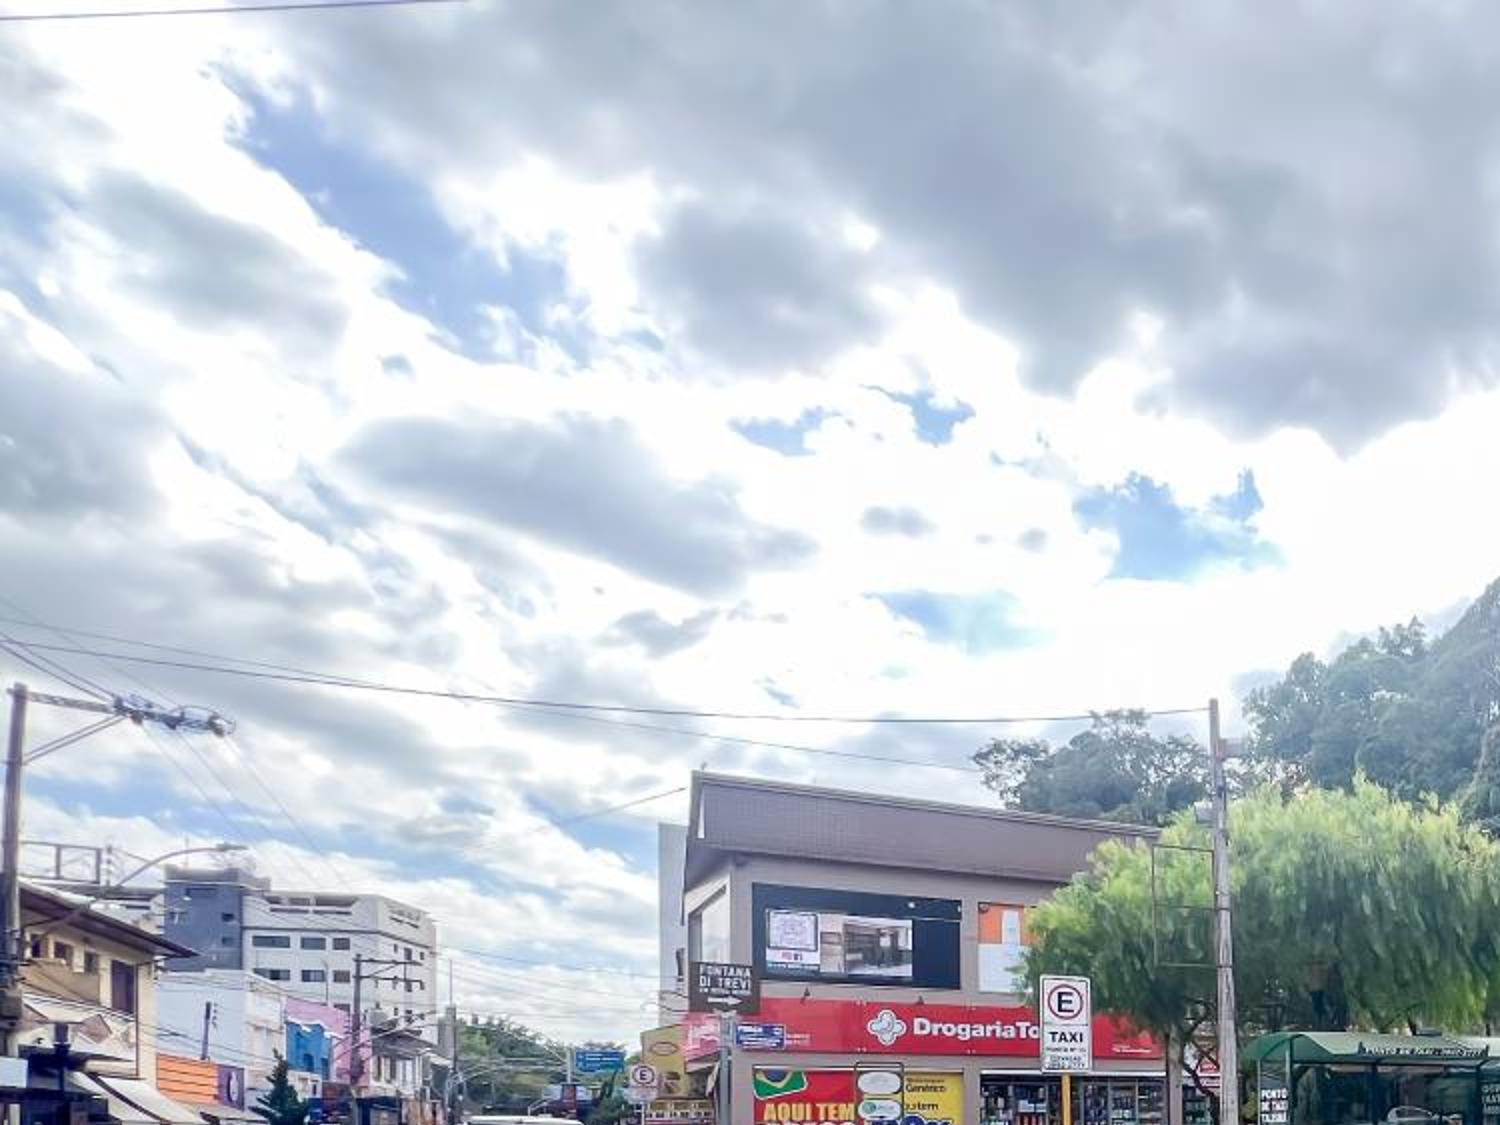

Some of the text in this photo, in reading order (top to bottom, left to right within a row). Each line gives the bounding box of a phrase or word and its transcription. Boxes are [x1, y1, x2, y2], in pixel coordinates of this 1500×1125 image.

[700, 965, 752, 977] FONTANA
[700, 975, 752, 991] DI TREVI
[1057, 991, 1075, 1013] E
[913, 1017, 1040, 1041] DrogariaTo
[1048, 1031, 1083, 1042] TAXI
[1261, 1088, 1288, 1099] PONTO
[764, 1101, 856, 1121] AQUI TEM
